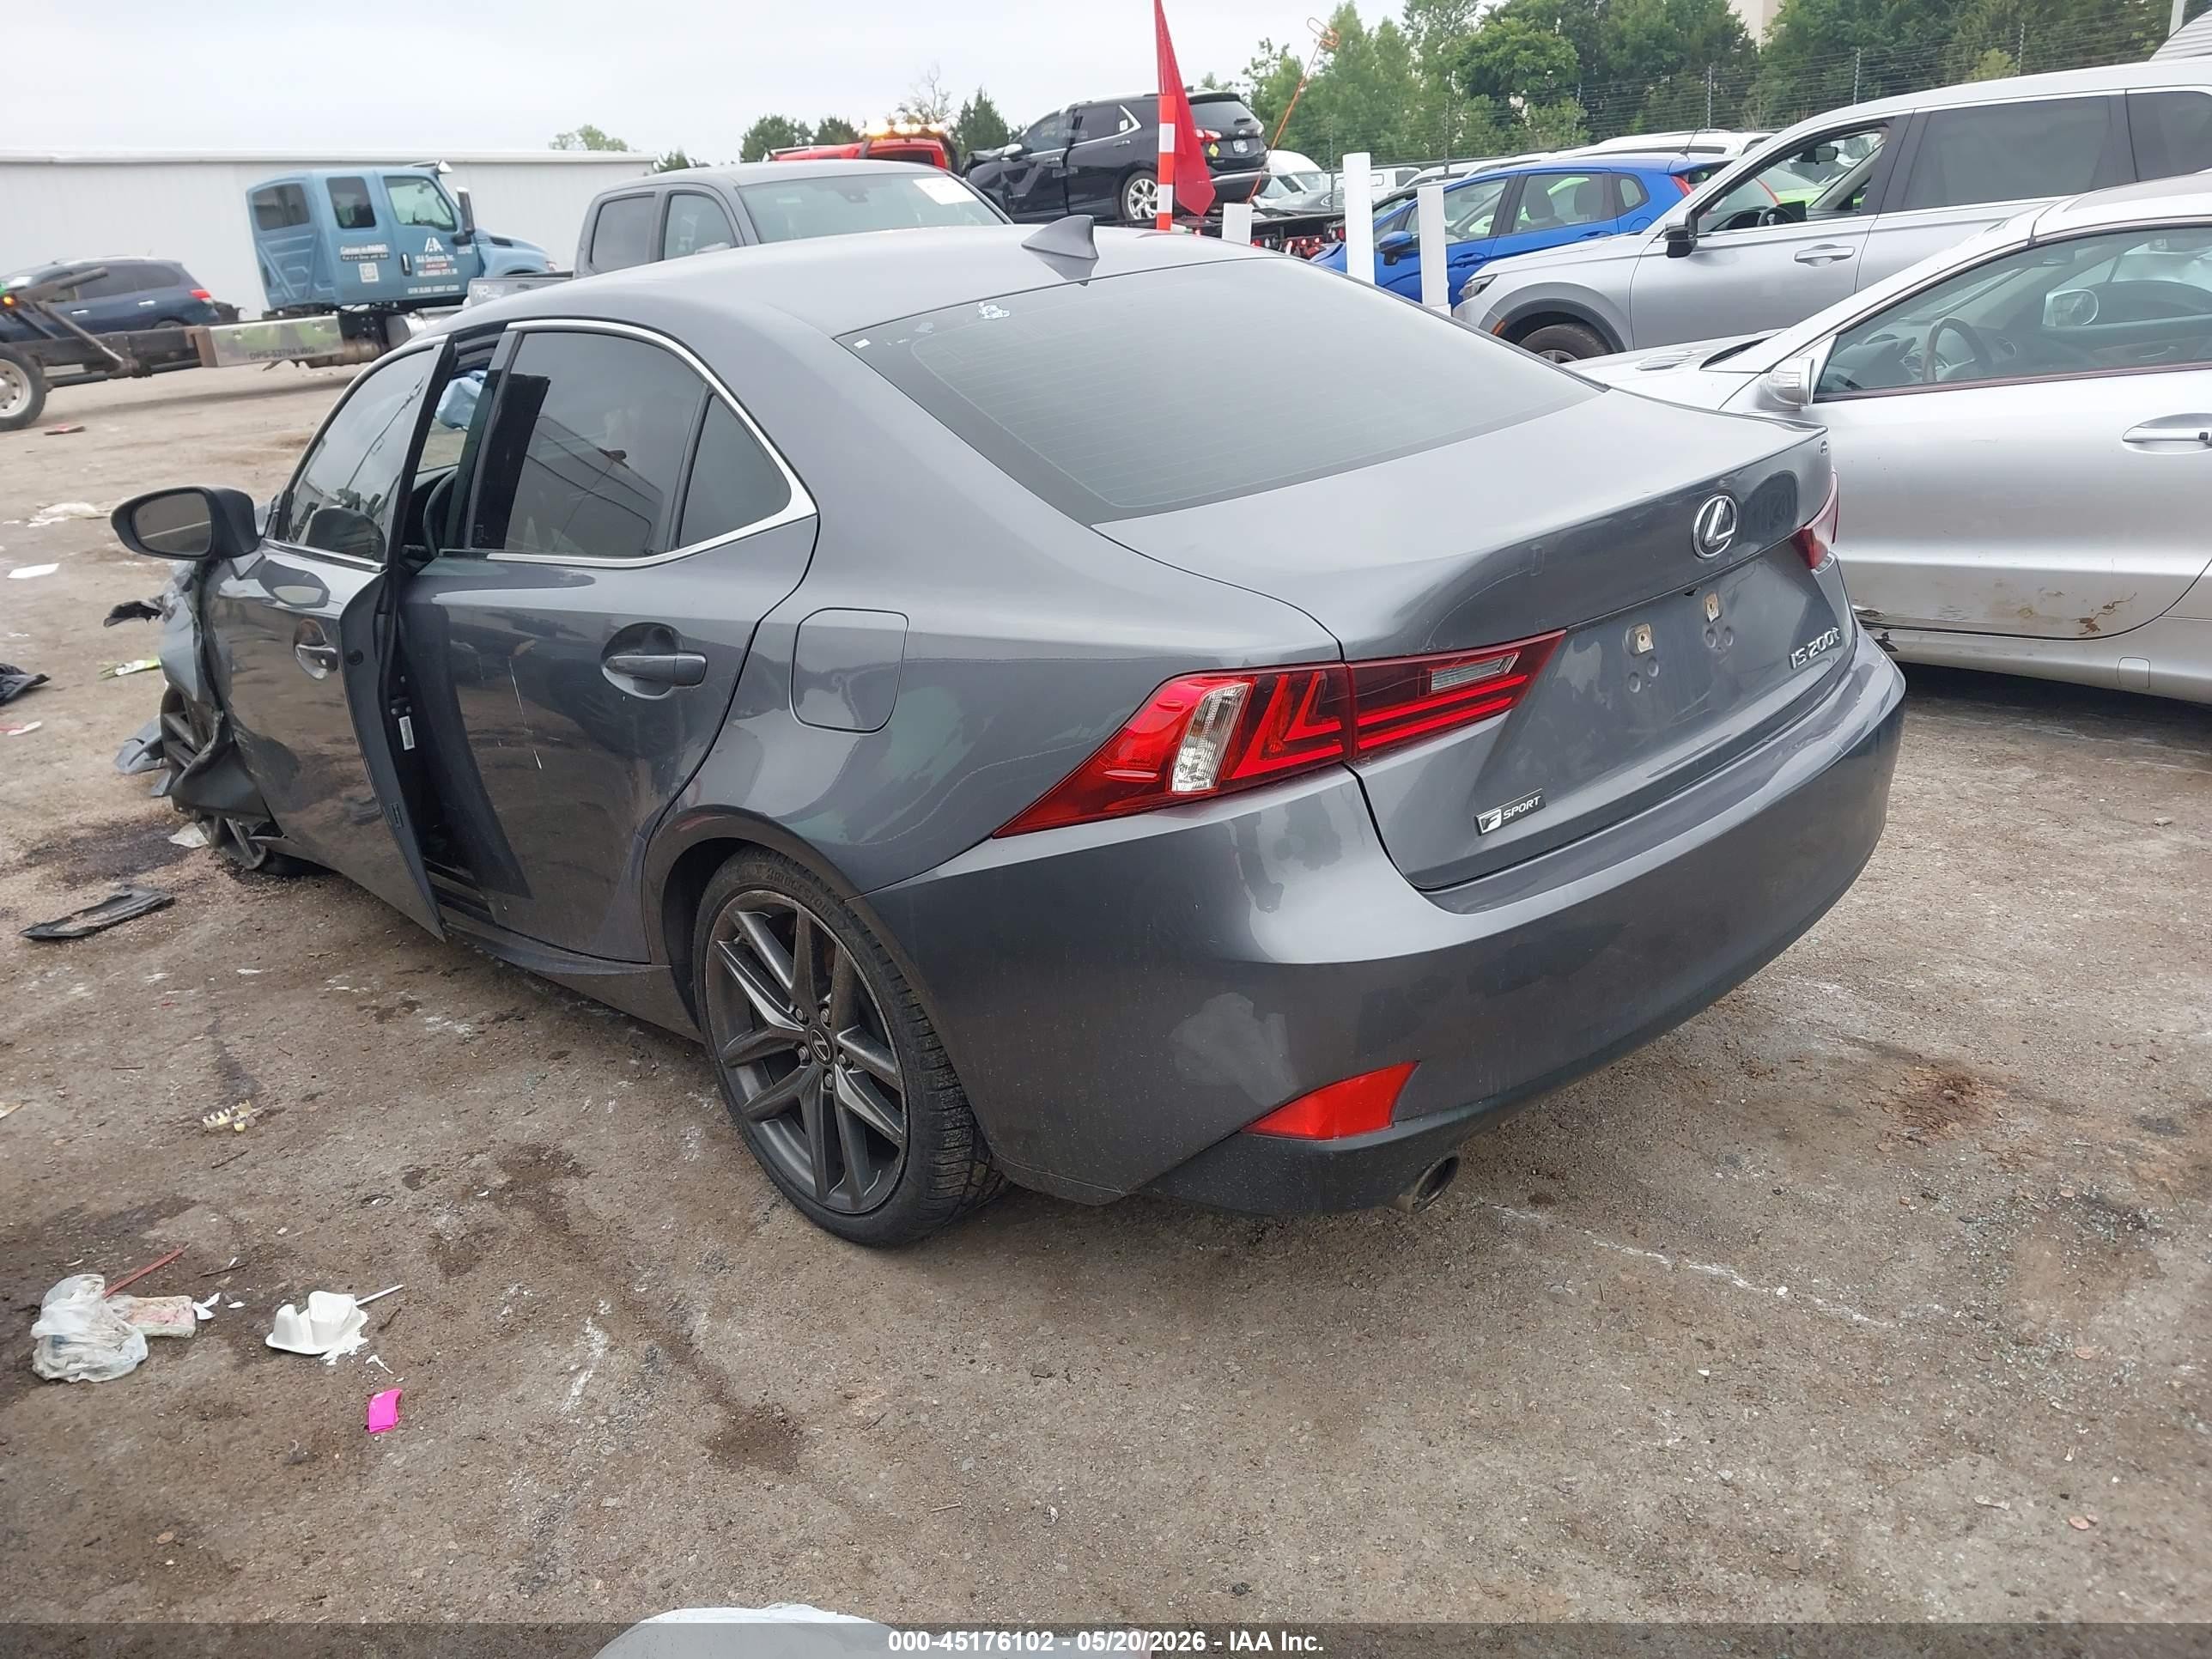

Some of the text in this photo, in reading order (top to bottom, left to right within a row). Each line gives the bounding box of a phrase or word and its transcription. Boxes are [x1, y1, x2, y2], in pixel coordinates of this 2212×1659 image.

[1790, 627, 1841, 669] IS 200t
[1478, 795, 1541, 833] F SPORT
[766, 867, 836, 918] BRIDGESTONE
